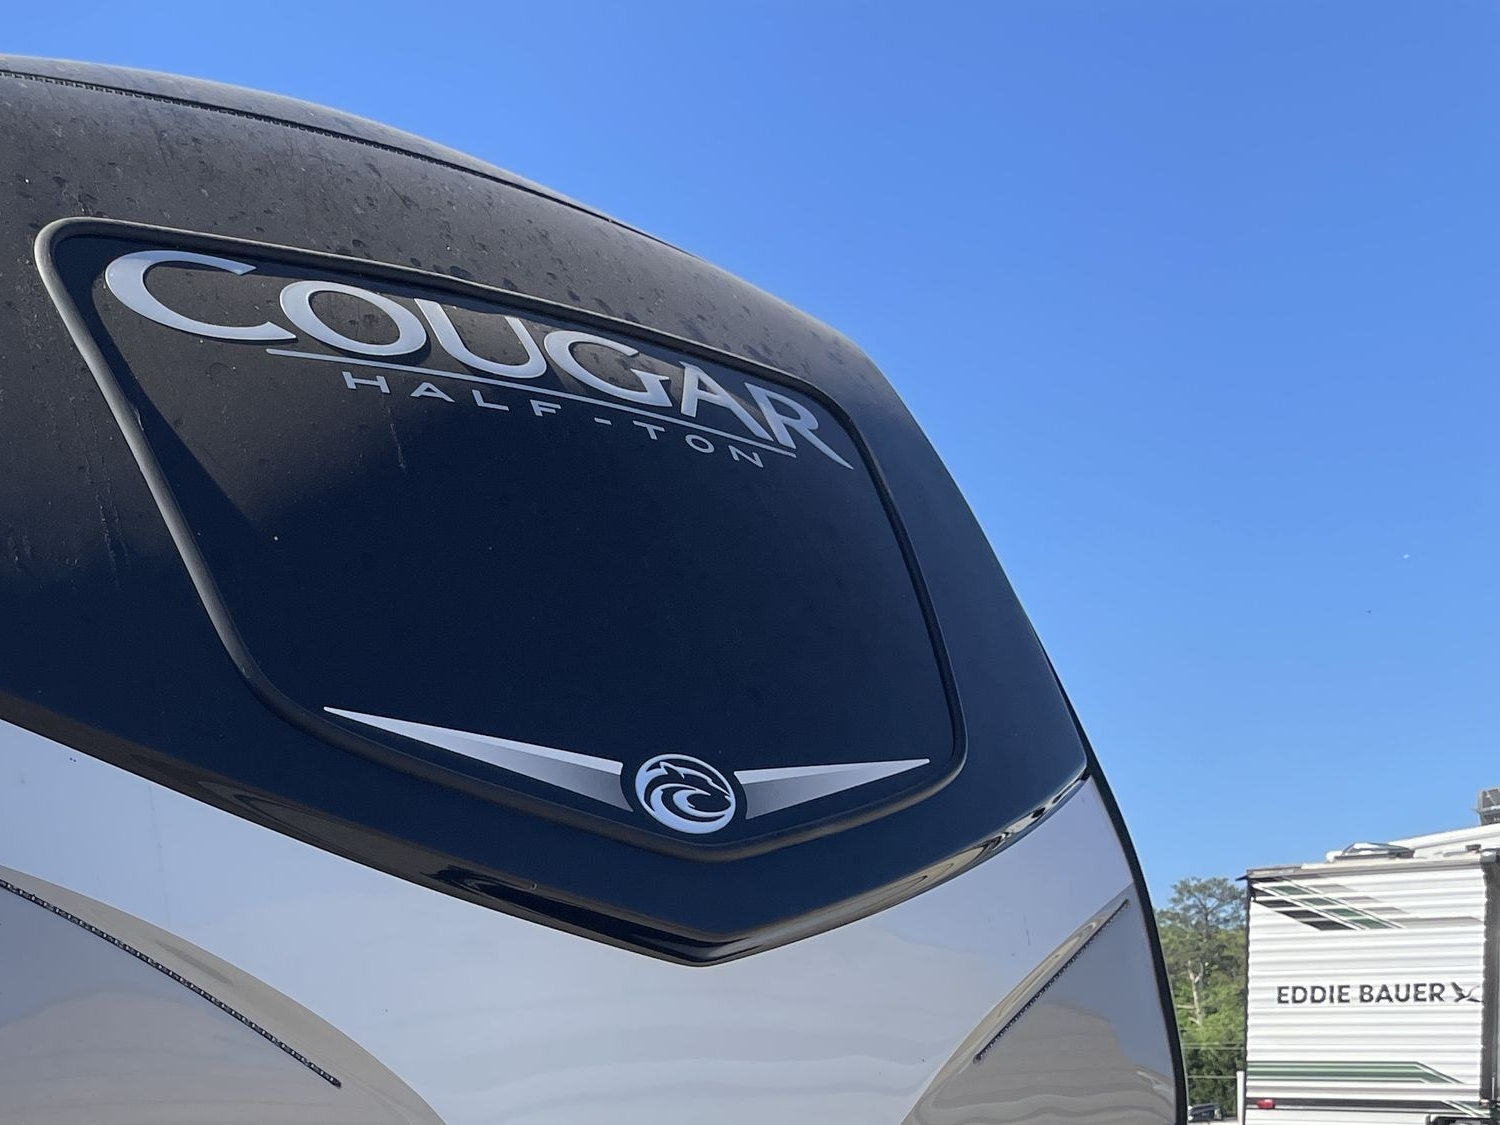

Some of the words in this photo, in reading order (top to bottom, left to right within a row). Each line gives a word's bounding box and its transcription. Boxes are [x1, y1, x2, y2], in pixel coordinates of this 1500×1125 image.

[105, 249, 855, 471] COUGAR
[341, 370, 766, 470] HALF-TON
[1276, 984, 1351, 1005] EDDIE
[1358, 982, 1446, 1004] BAUER
